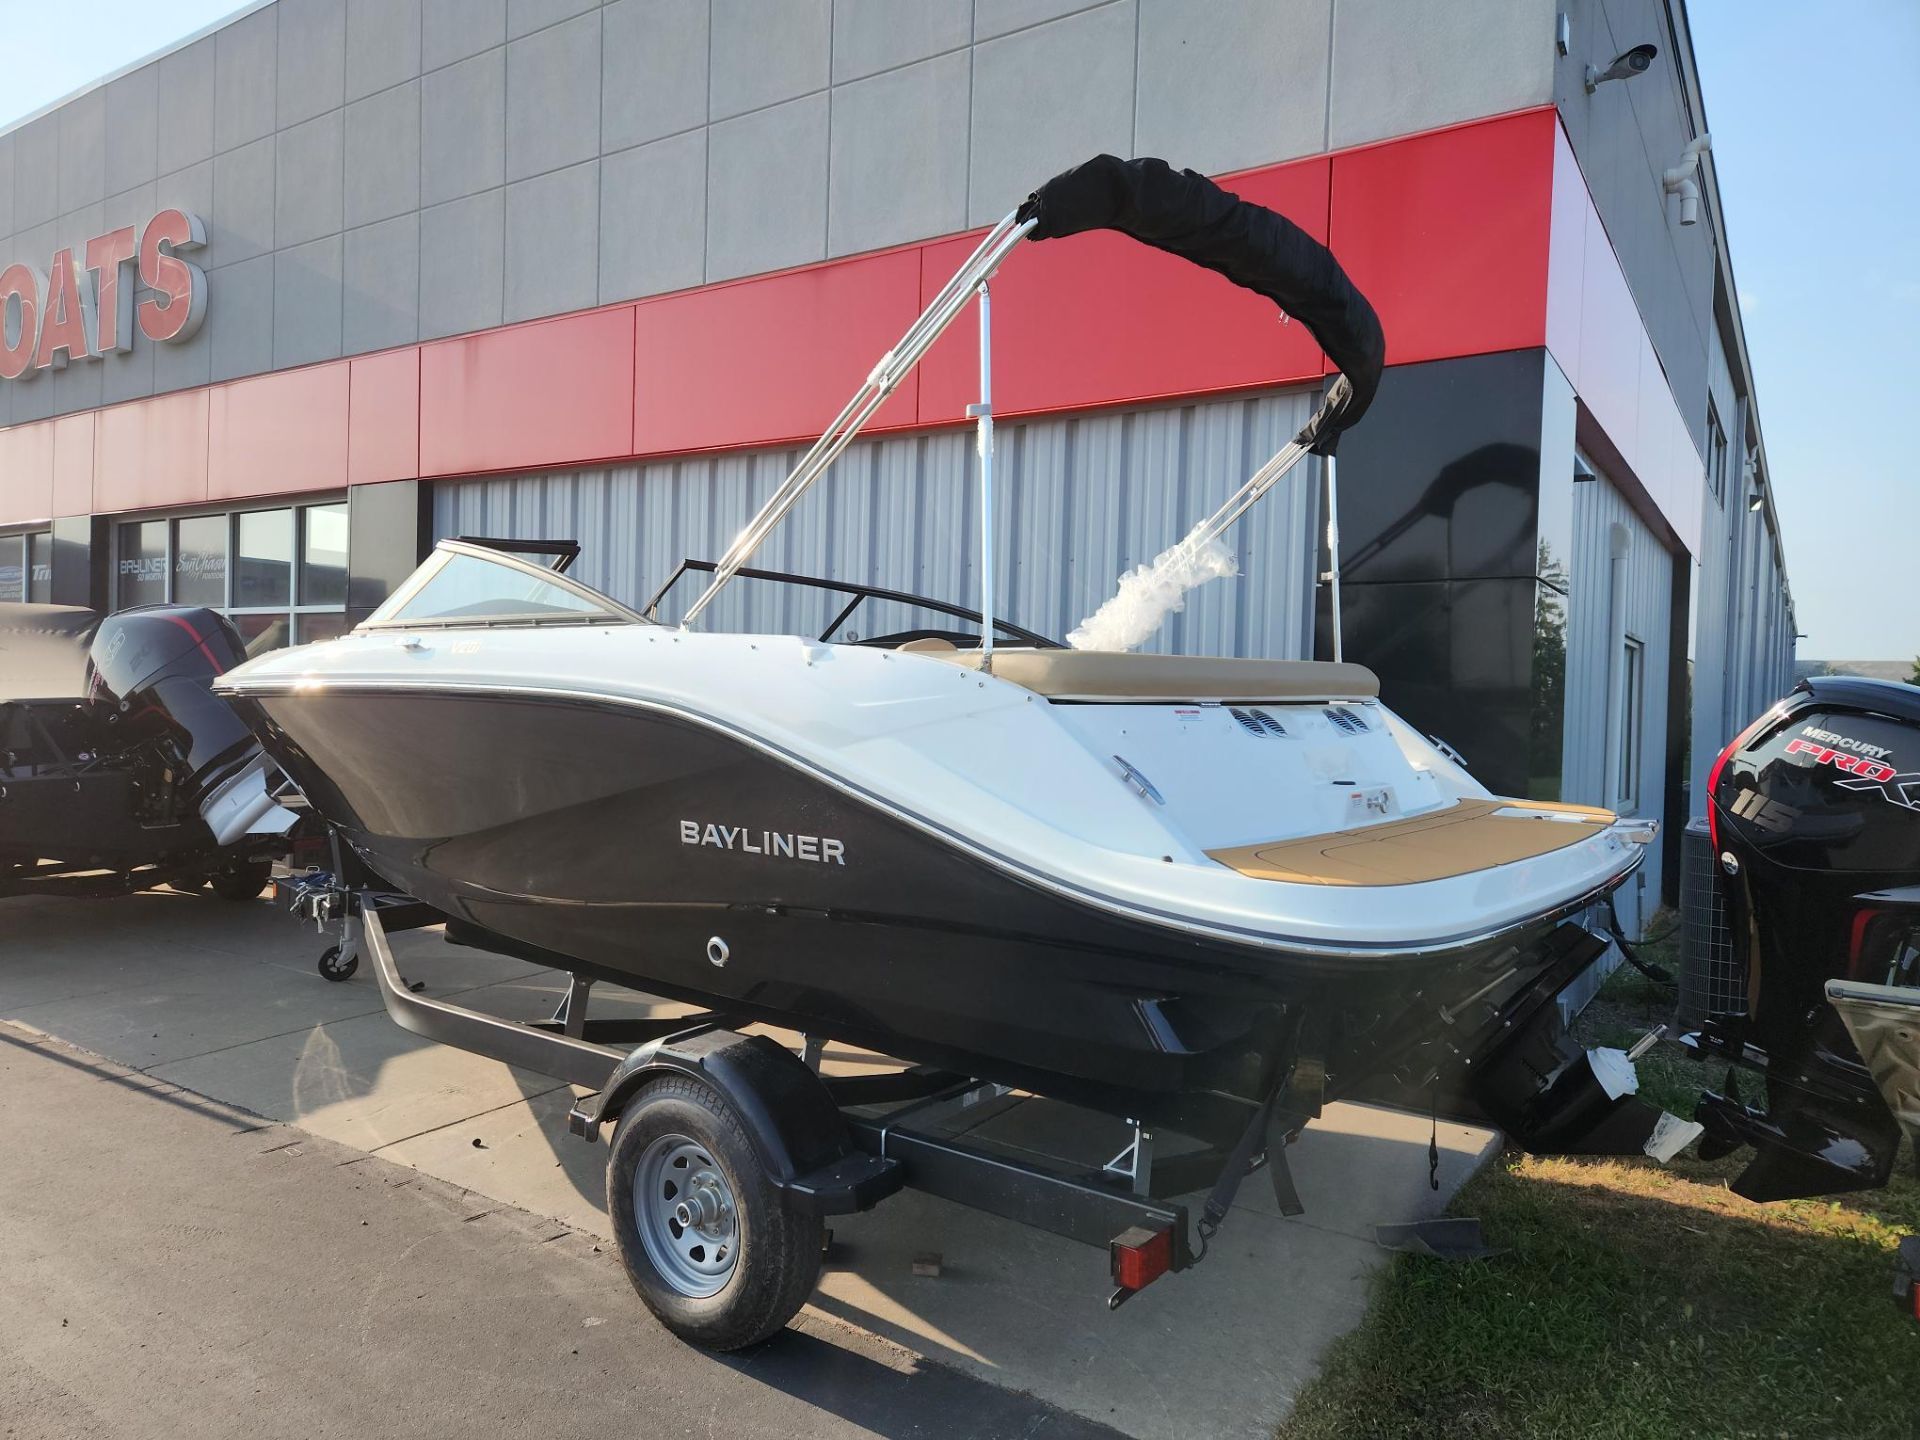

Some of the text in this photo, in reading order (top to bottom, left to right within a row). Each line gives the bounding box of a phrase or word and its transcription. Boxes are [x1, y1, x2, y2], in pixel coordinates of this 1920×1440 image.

[0, 207, 208, 380] OATS
[1784, 739, 1897, 782] PRO
[1802, 726, 1893, 758] MERCURY
[1730, 787, 1804, 833] 115
[679, 819, 846, 866] BAYLINER
